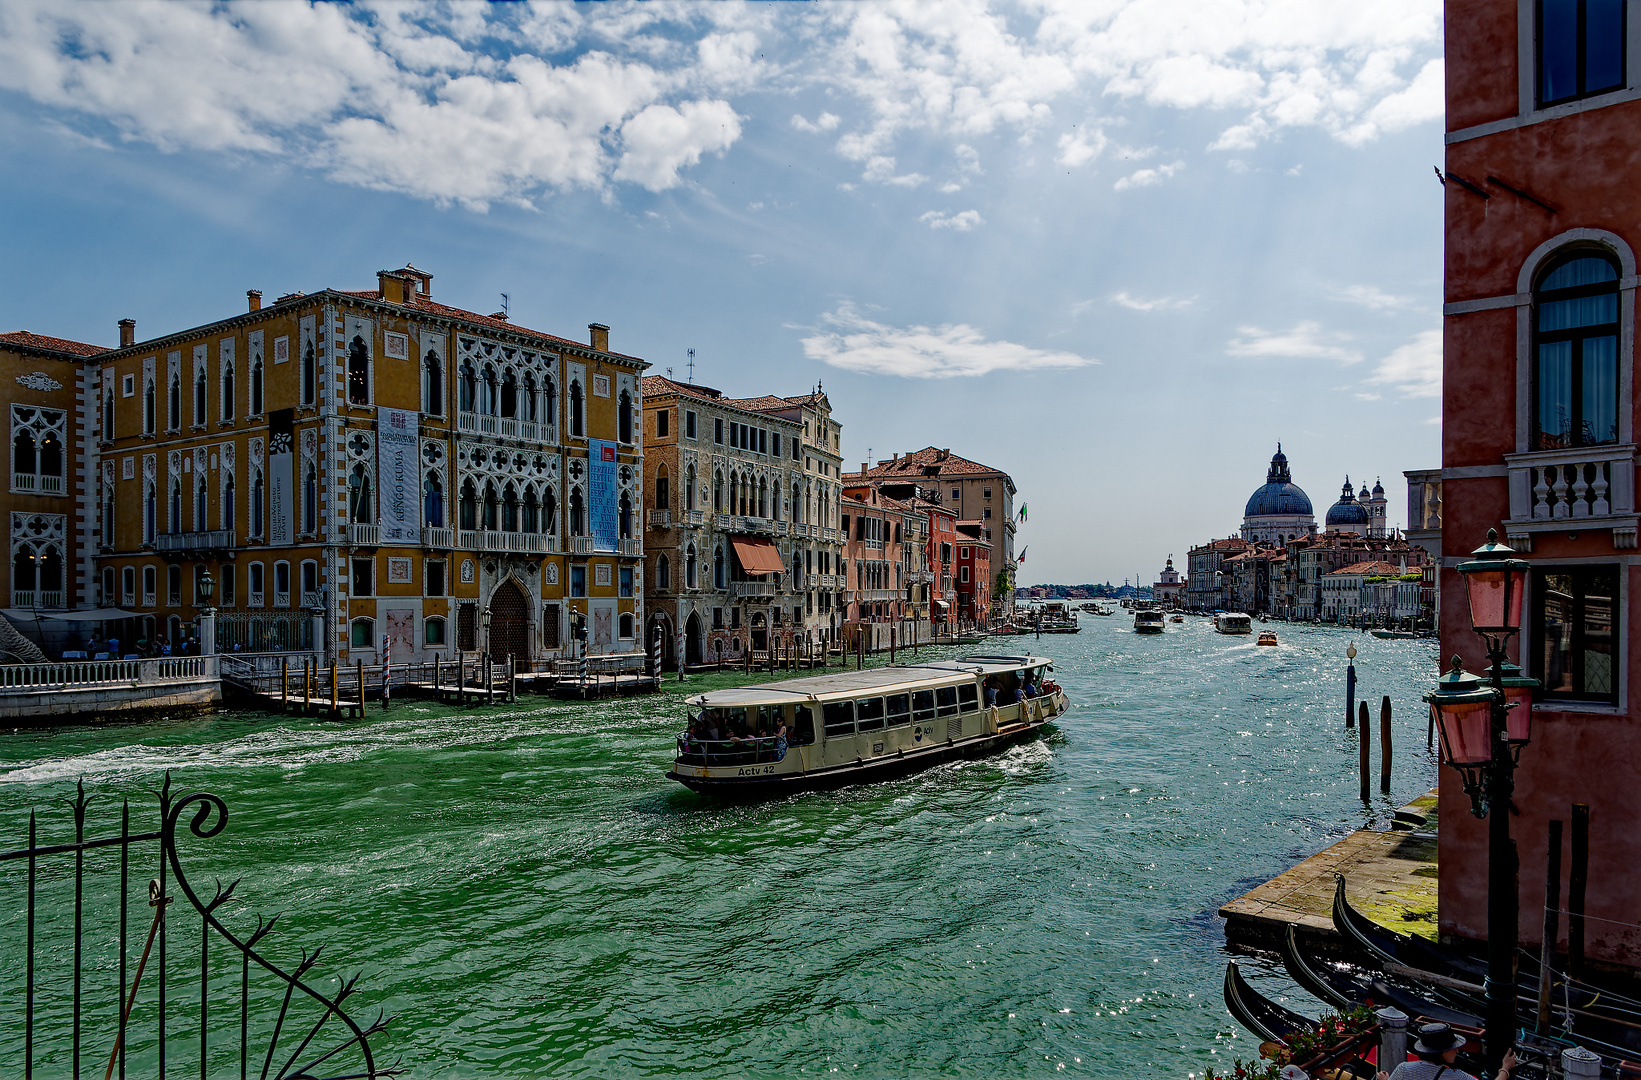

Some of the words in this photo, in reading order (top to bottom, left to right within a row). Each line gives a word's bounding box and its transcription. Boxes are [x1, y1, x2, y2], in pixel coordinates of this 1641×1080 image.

[395, 450, 404, 481] KUMA
[591, 465, 616, 475] FERTILE
[591, 473, 612, 483] FERTIL
[591, 481, 608, 490] FERTI
[591, 489, 606, 498] FERT
[395, 485, 404, 522] KENGO
[591, 497, 603, 505] FER
[606, 498, 616, 506] FU
[591, 505, 600, 513] FE
[603, 505, 616, 514] FUT
[601, 513, 616, 522] FUTU
[595, 529, 616, 538] FUTURE
[594, 537, 616, 546] UTURES
[738, 767, 761, 776] Actv
[763, 765, 775, 774] 42
